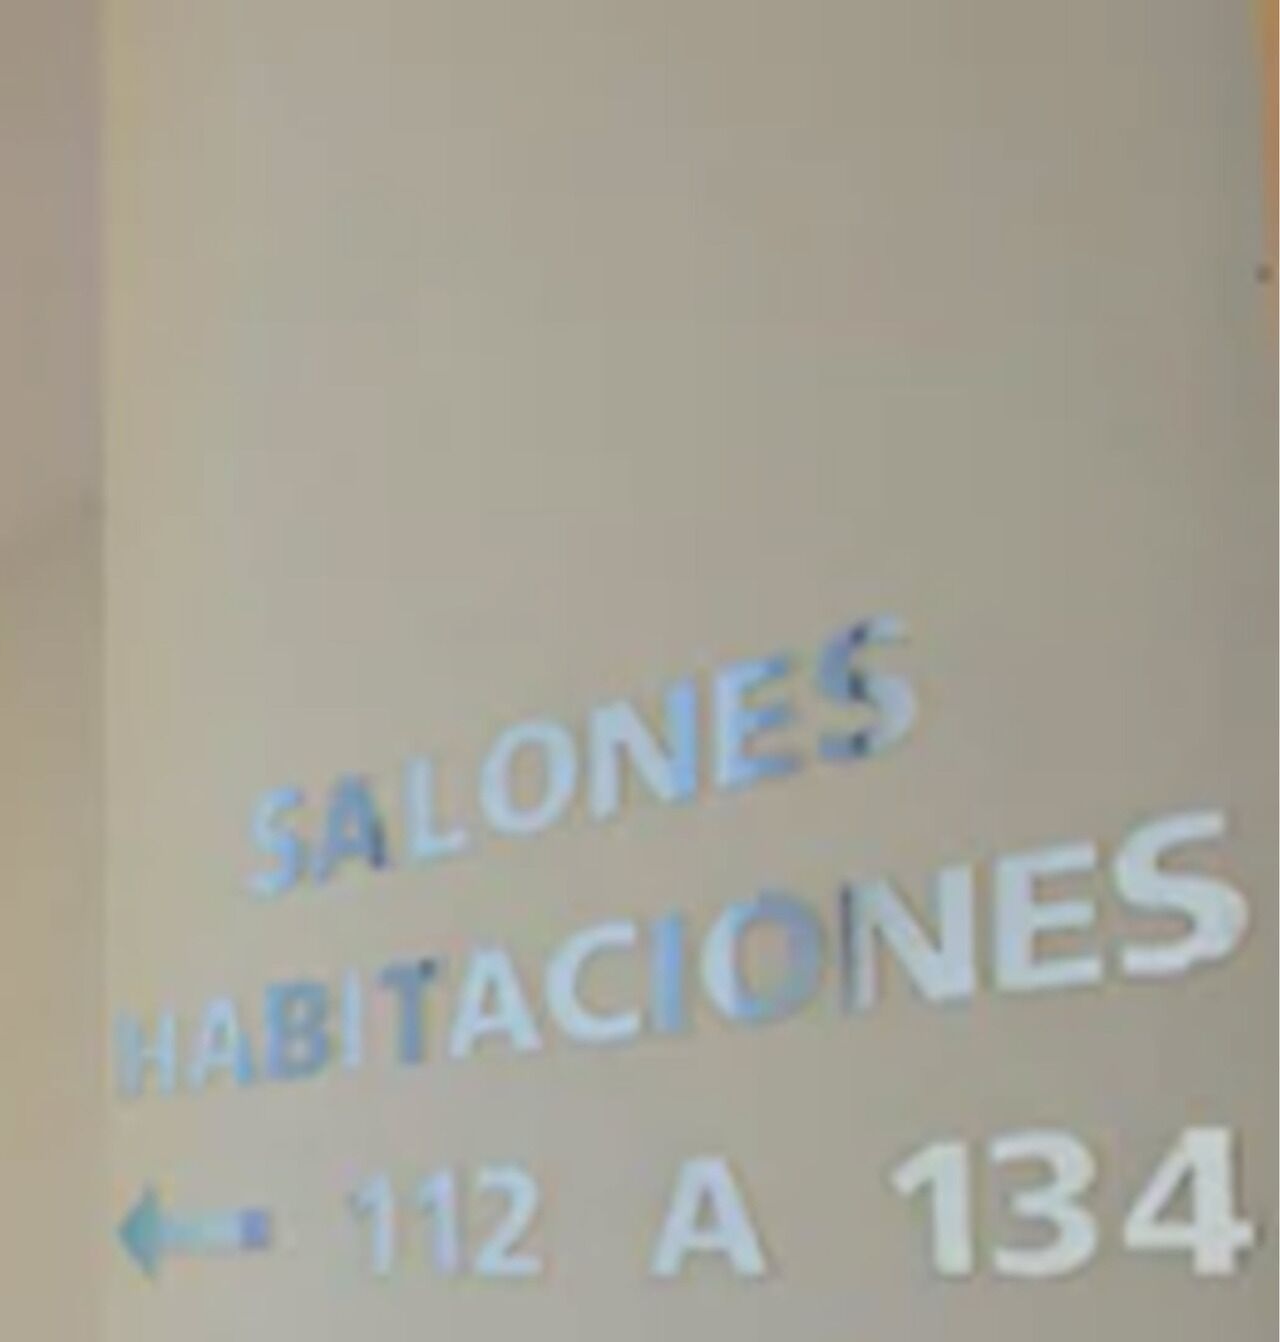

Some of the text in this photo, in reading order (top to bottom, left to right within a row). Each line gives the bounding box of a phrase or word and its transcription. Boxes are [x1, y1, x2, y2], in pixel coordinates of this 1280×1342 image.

[247, 613, 918, 898] SALONES
[114, 809, 1248, 1099] HABITACIONES
[349, 1125, 1255, 1277] 112 A 134
